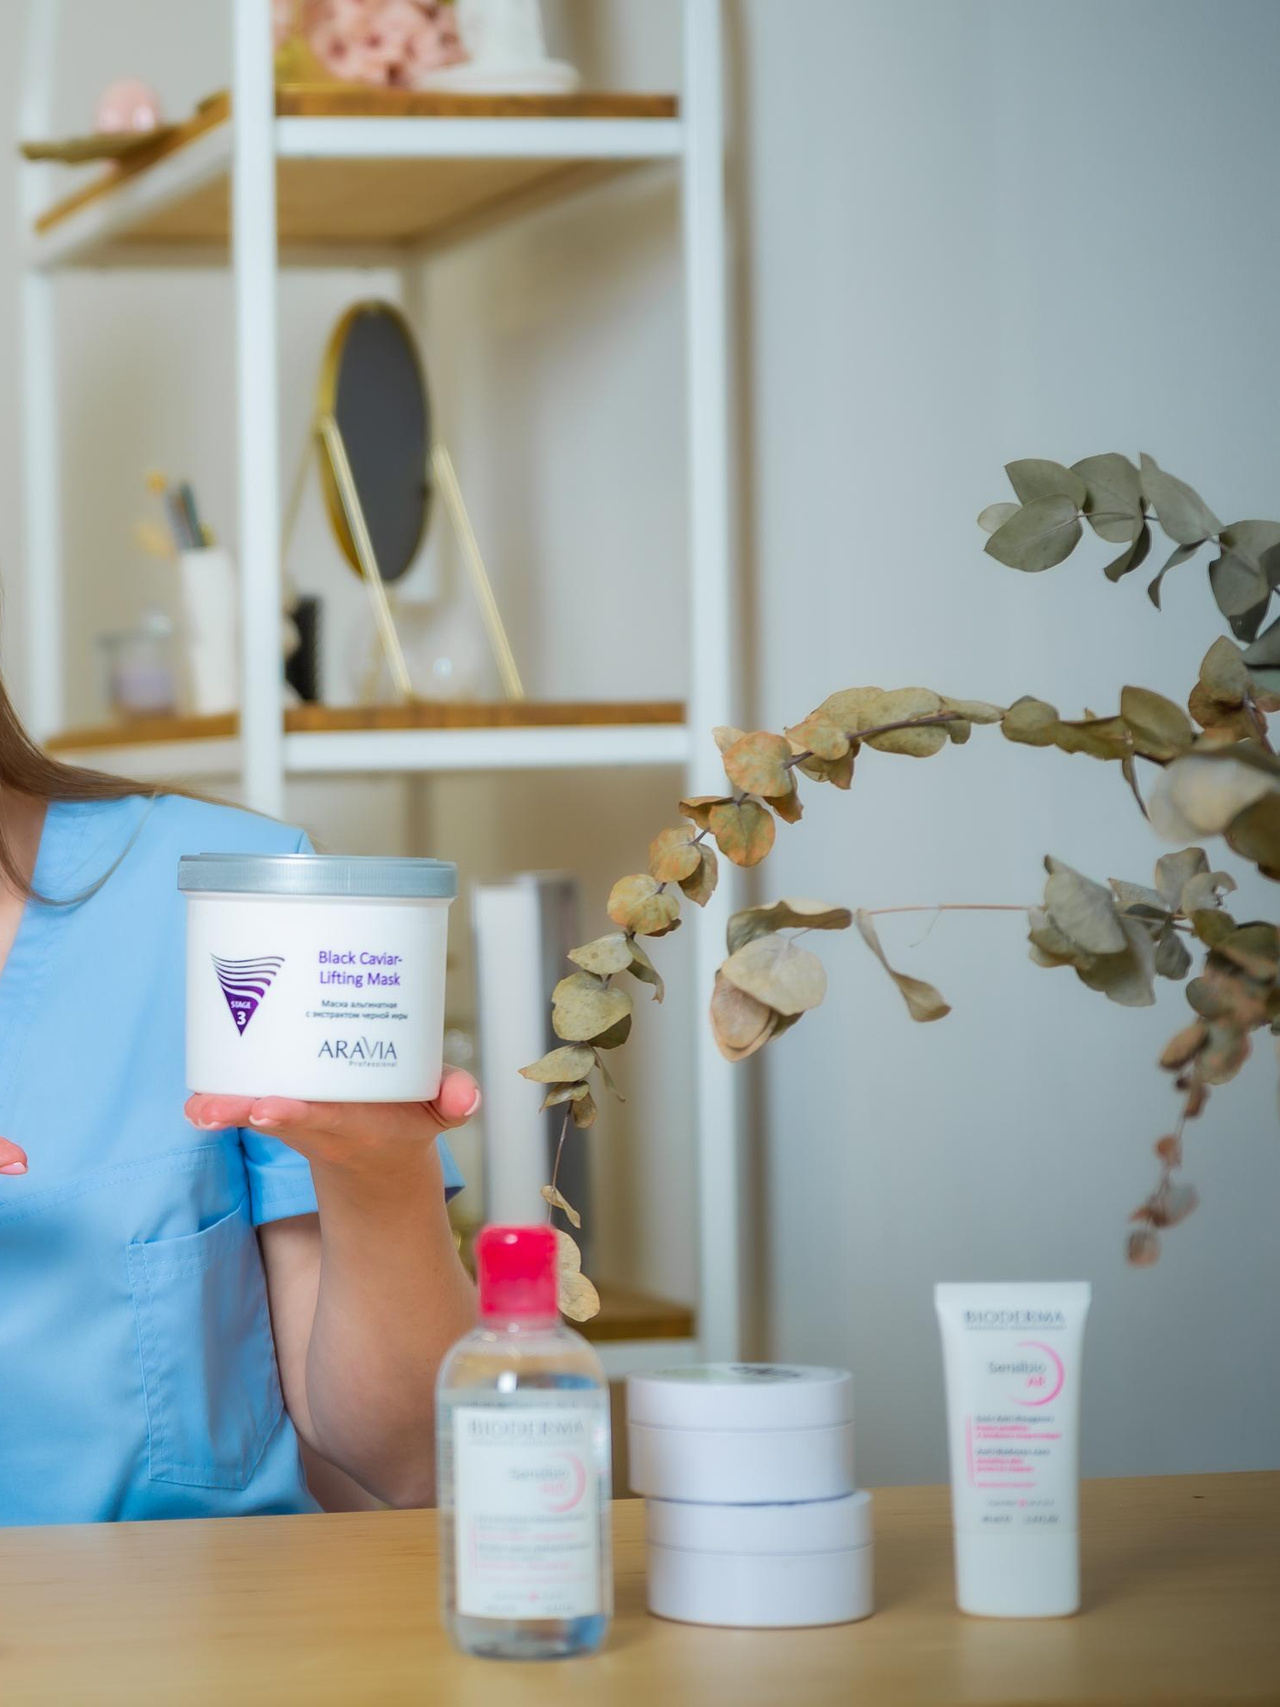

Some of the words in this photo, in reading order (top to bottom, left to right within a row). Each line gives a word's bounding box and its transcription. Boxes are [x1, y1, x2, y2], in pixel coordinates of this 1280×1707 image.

[318, 950, 356, 964] Black
[360, 951, 403, 966] Caviar-
[320, 970, 363, 988] Lifting
[367, 971, 401, 986] Mask
[230, 1000, 251, 1009] STAGE
[322, 1000, 348, 1008] Маска
[236, 1010, 247, 1026] 3
[318, 1036, 398, 1060] ARAVIA
